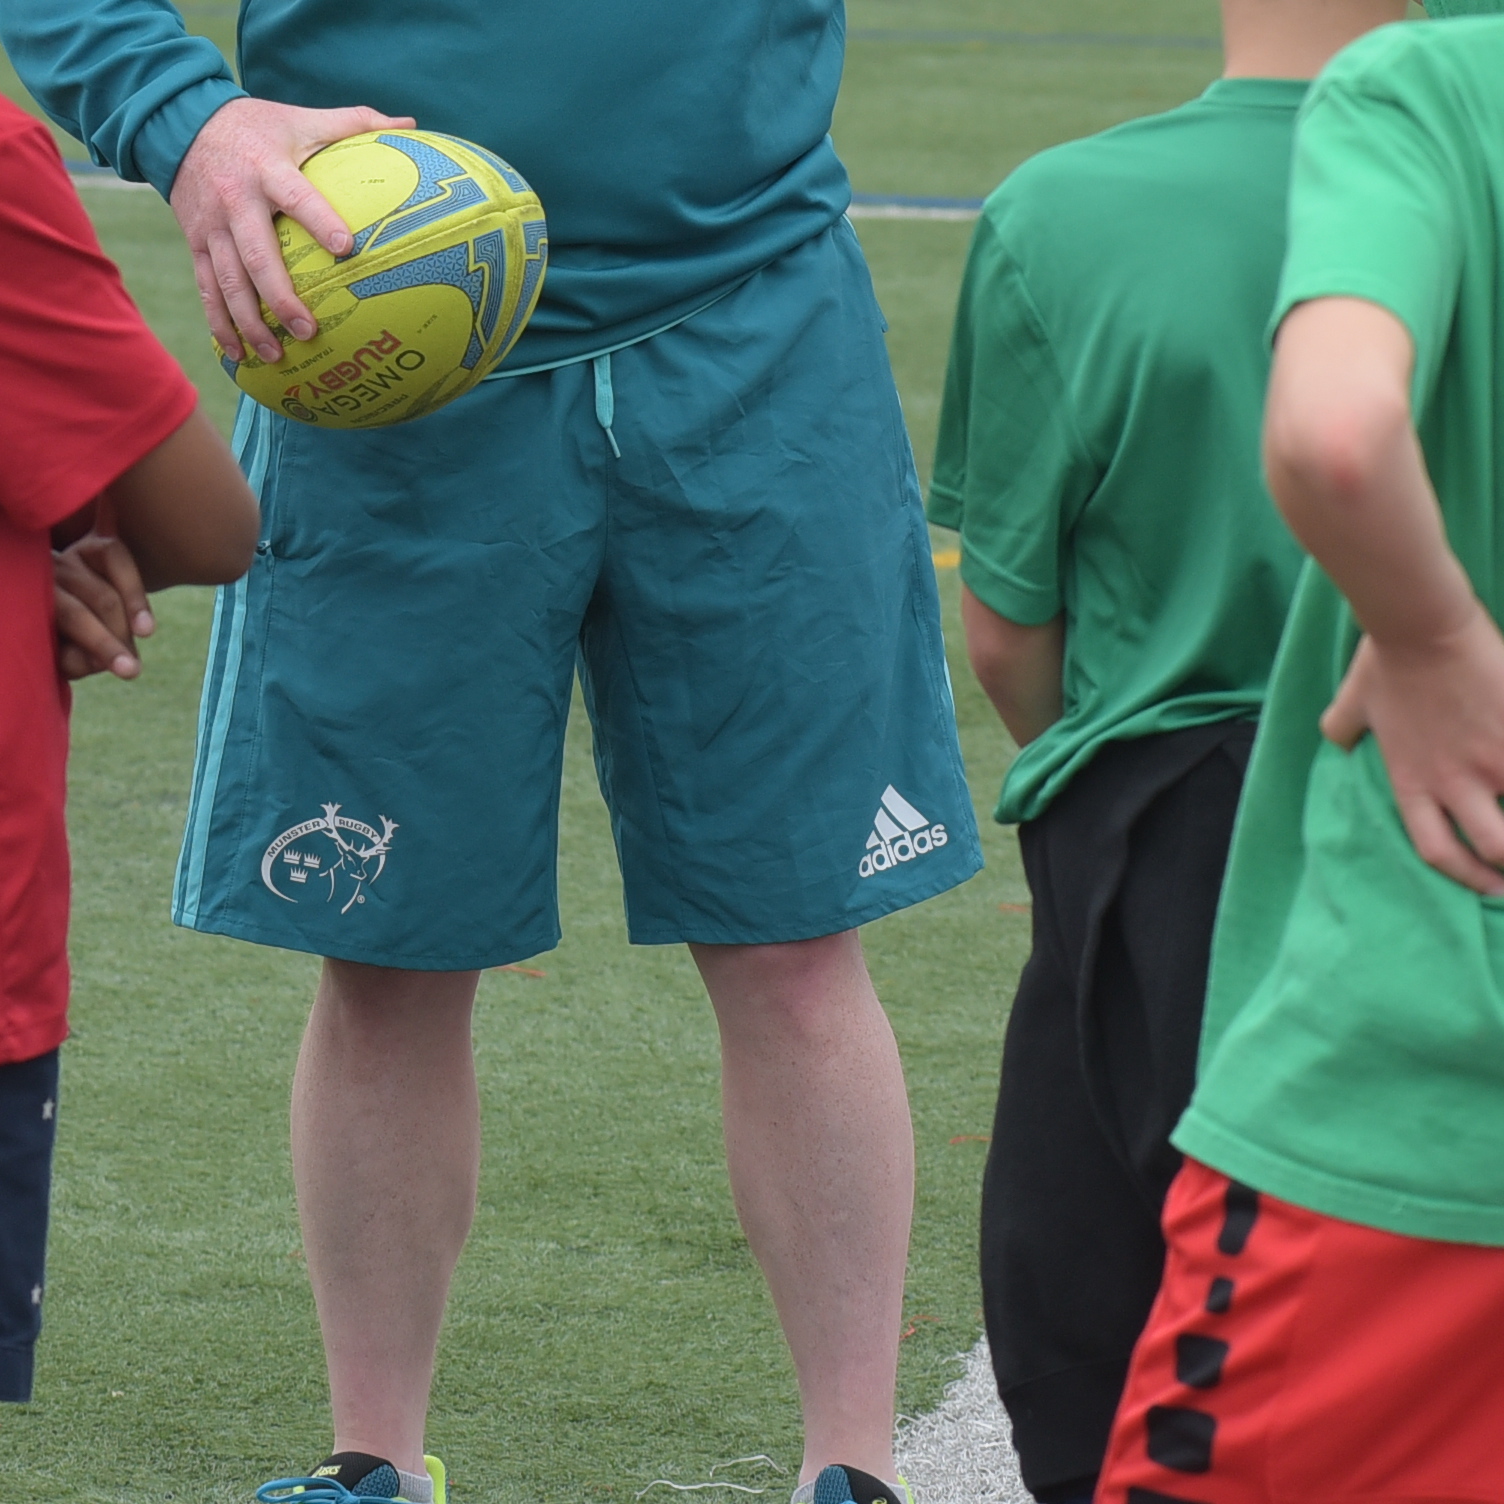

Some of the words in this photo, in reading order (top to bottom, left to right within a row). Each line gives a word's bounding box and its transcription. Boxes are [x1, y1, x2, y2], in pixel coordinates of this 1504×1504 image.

[279, 365, 300, 377] BALL
[301, 346, 335, 371] TRAINER
[304, 329, 403, 399] RUGBY
[311, 349, 426, 417] OMEGA
[349, 393, 409, 424] PRECISION
[267, 820, 321, 858] MUNSTER
[338, 818, 378, 839] RUGBY
[859, 824, 948, 878] adidas
